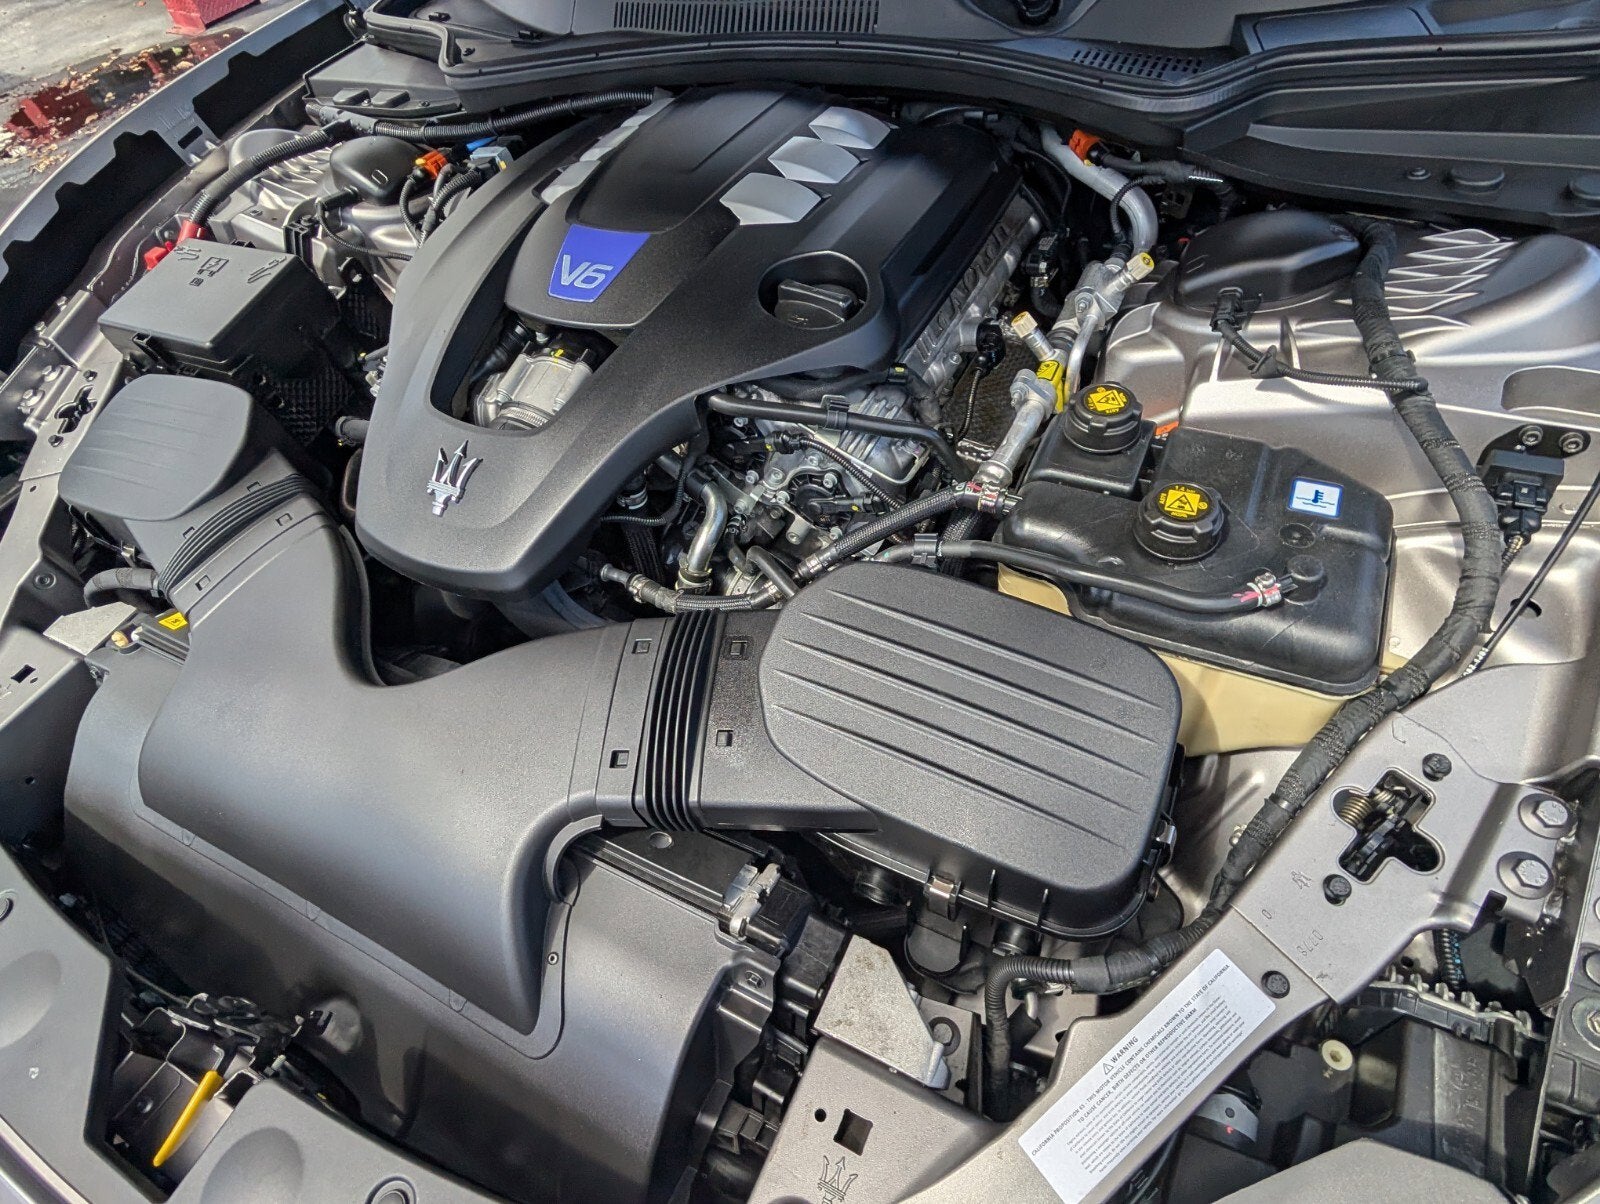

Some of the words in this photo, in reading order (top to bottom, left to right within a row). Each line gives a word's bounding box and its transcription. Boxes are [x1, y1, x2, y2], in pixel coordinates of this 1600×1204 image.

[561, 254, 614, 289] V6
[1030, 1132, 1055, 1156] CALIFORNIA
[1052, 1108, 1080, 1134] PROPOSITION
[1094, 1078, 1110, 1094] MOTOR
[1109, 1064, 1125, 1080] VEHICLE
[1124, 1046, 1144, 1066] CONTAINS
[1142, 1026, 1164, 1048] CHEMICALS
[1177, 1006, 1185, 1014] TO
[1183, 1000, 1192, 1008] THE
[1206, 963, 1230, 986] CALIFORNIA
[1083, 1104, 1096, 1117] CAUSE
[1111, 1077, 1124, 1090] BIRTH
[1122, 1062, 1140, 1079] DEFECTS
[1138, 1056, 1146, 1064] OR
[1144, 1045, 1158, 1058] OTHER
[1157, 1018, 1185, 1046] REPRODUCTIVE
[1184, 1007, 1197, 1020] HARM
[1109, 1035, 1139, 1064] WARNING
